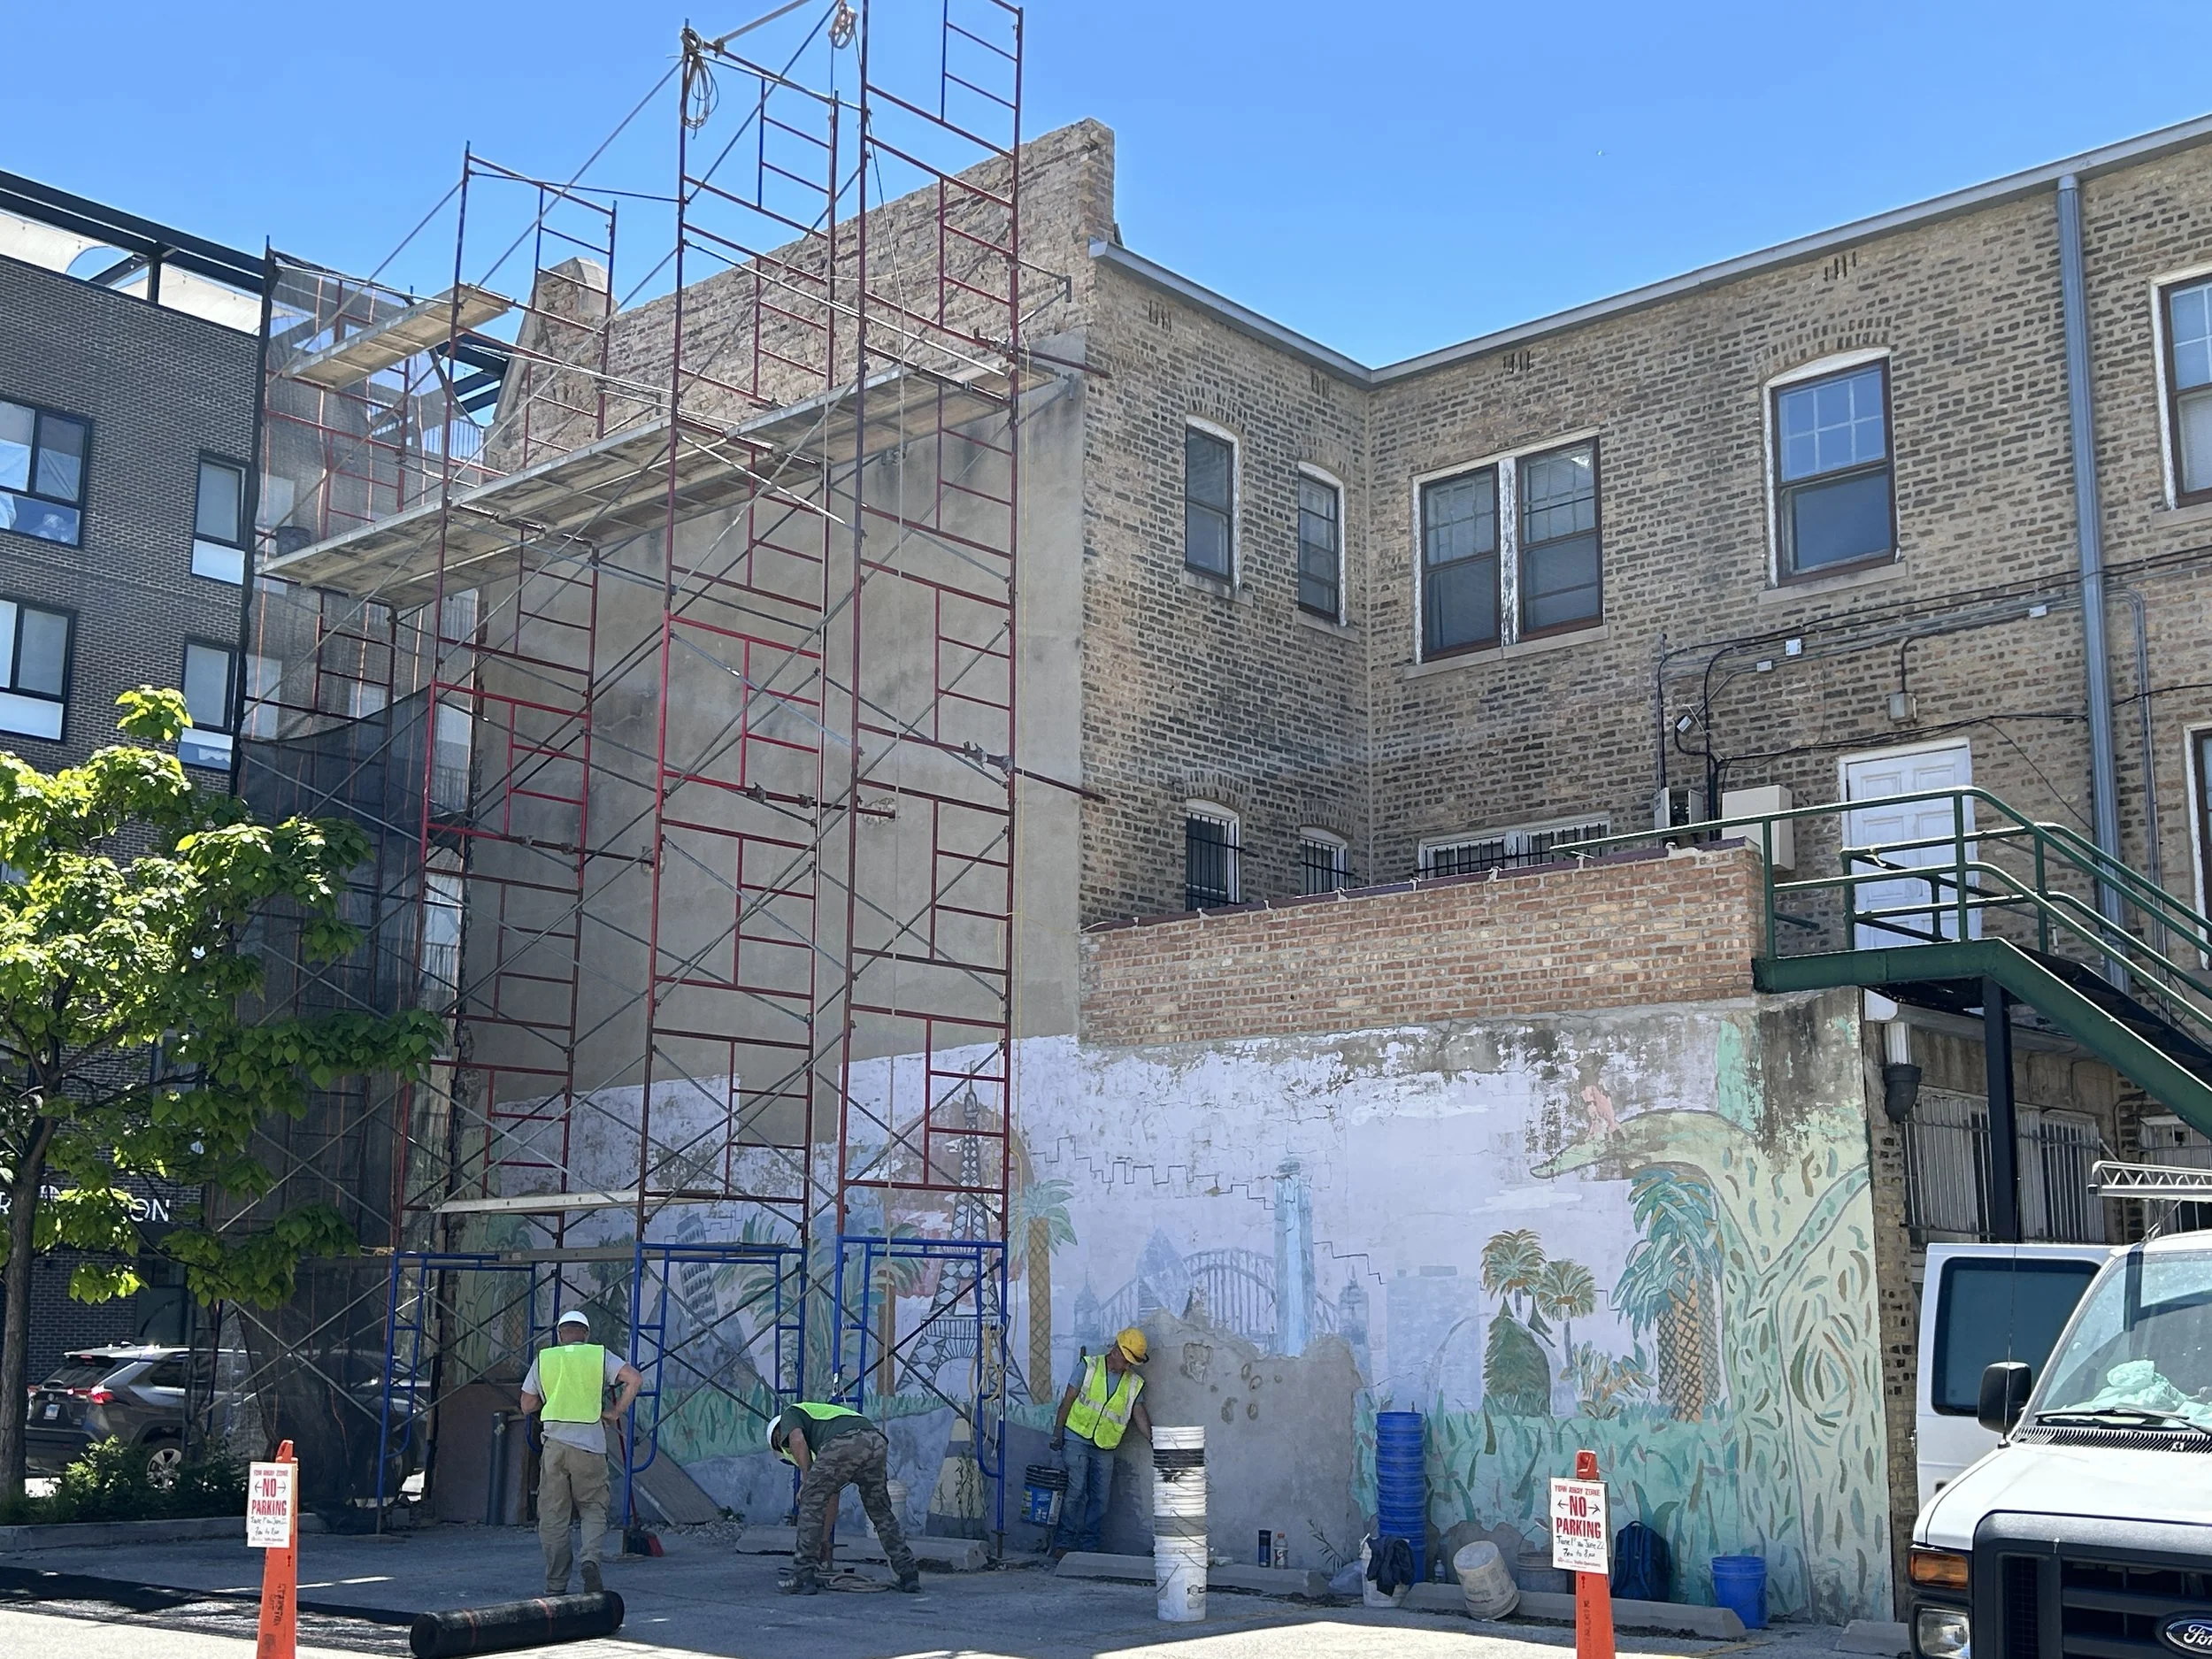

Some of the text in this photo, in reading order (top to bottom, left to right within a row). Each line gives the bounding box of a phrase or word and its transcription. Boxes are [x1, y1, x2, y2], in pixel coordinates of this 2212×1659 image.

[262, 1478, 277, 1497] NO
[251, 1499, 287, 1517] PARKING
[1570, 1495, 1586, 1517] NO
[1555, 1517, 1601, 1540] PARKING
[2183, 1624, 2212, 1646] For
